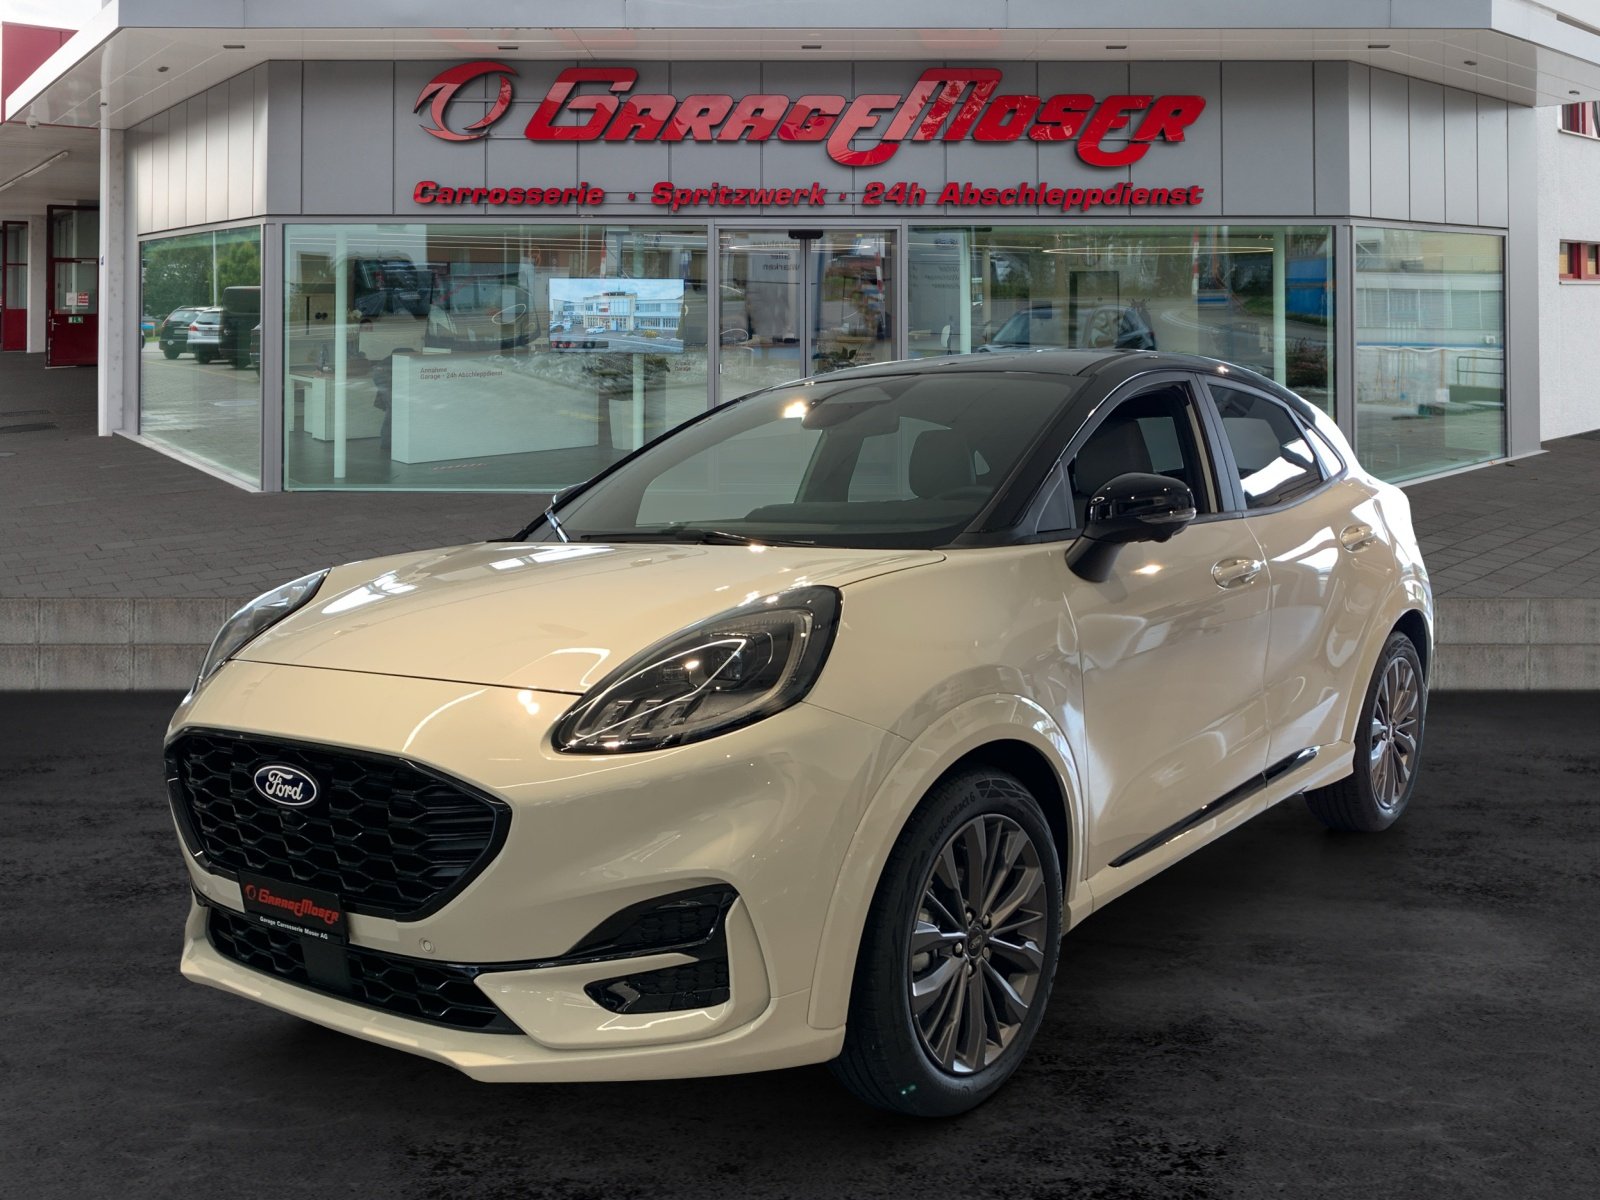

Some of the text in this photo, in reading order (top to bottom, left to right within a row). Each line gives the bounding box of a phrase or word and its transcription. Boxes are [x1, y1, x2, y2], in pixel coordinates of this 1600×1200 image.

[413, 180, 1204, 211] Carrosserie Spritzwerk 24h Abschleppdienst
[265, 770, 303, 801] Ford
[259, 916, 329, 940] Garage Carrosserie Moser AG
